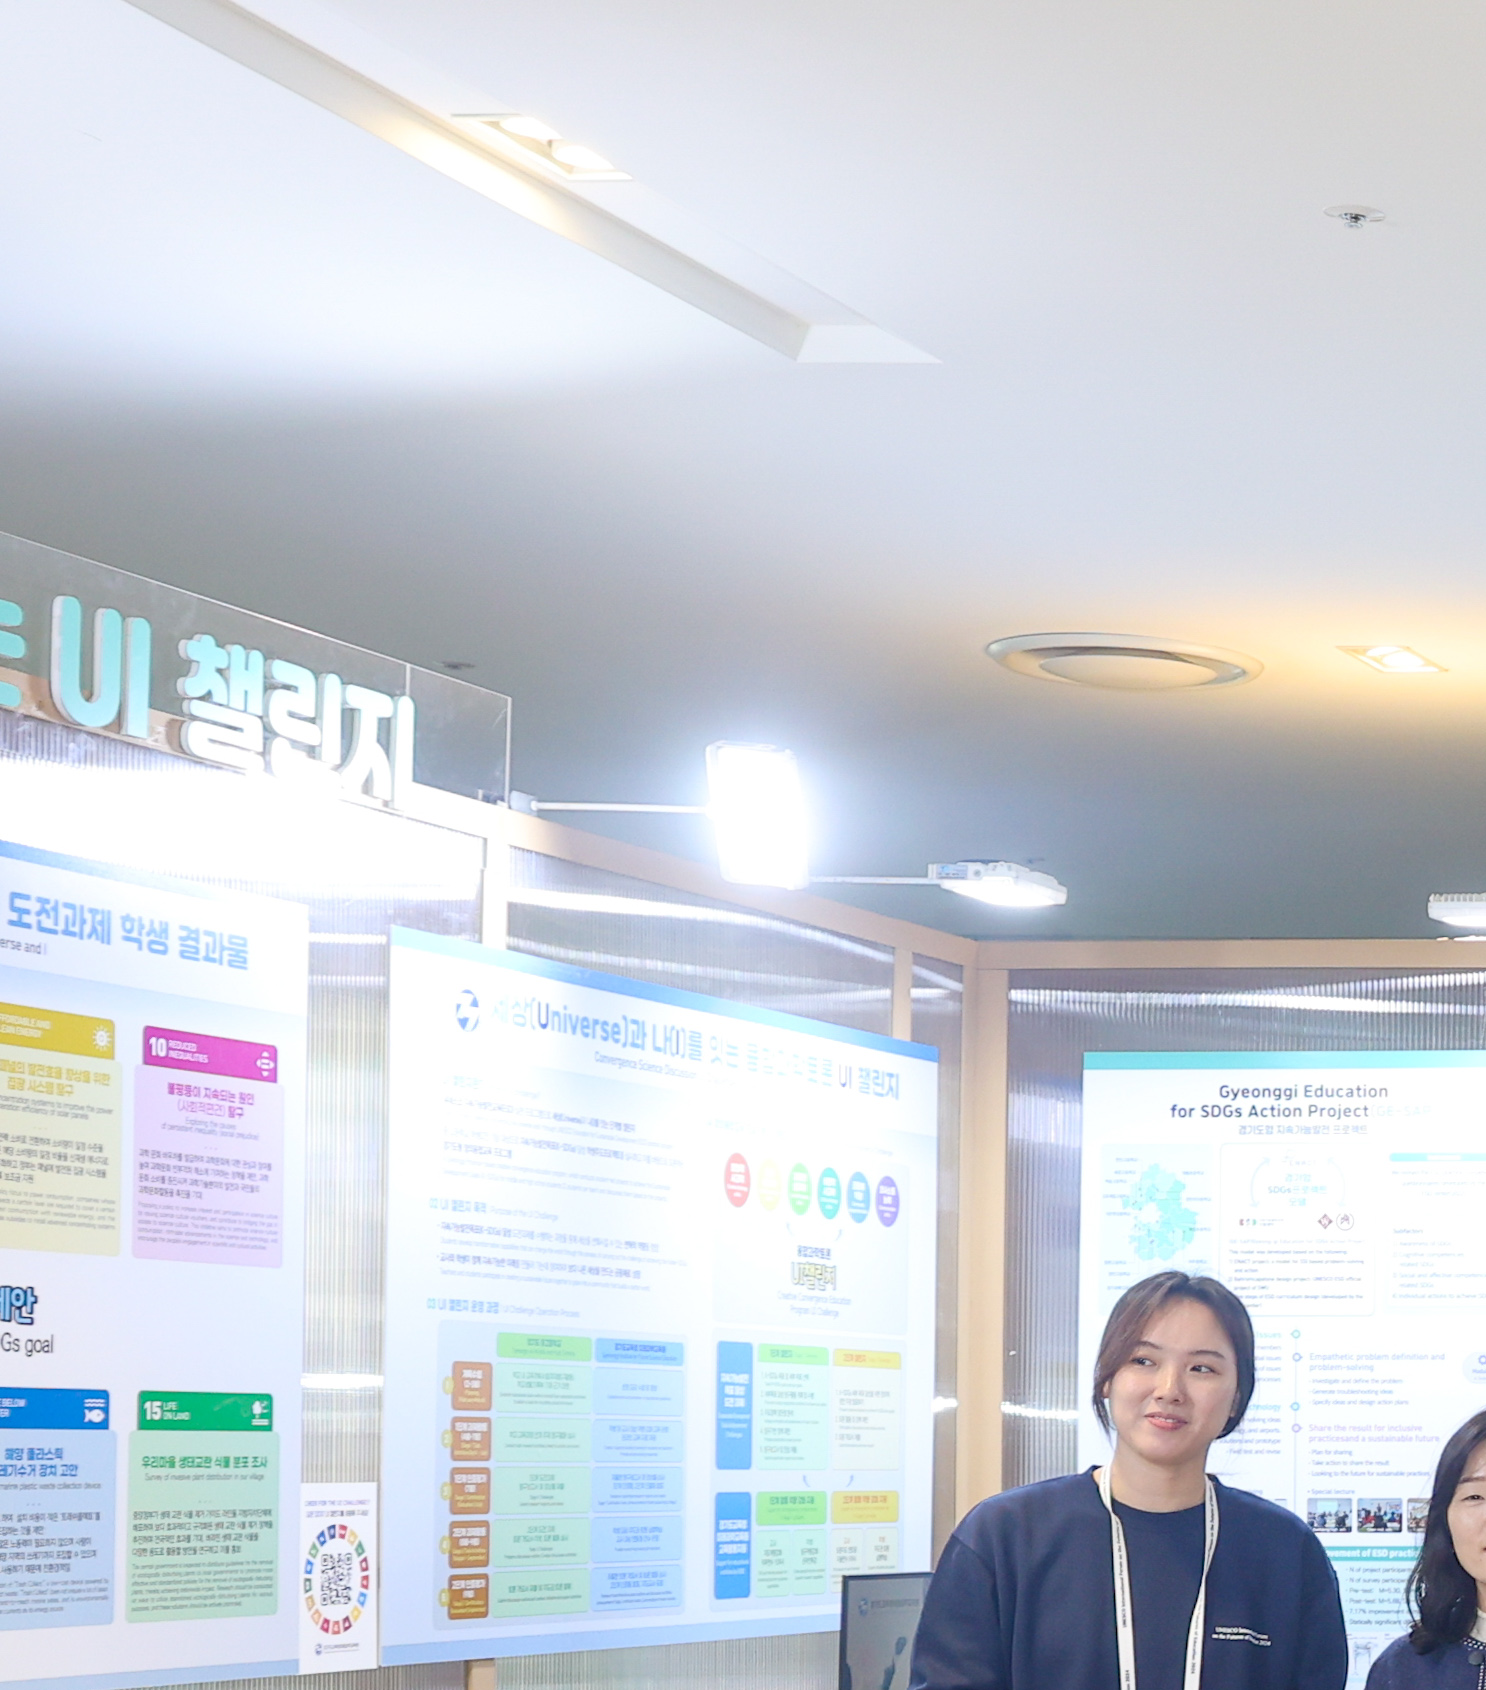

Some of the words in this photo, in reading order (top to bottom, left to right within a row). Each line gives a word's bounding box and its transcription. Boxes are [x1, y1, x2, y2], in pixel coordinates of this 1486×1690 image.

[51, 595, 151, 739] UI
[177, 634, 416, 808] 챌린지
[8, 891, 112, 945] 도전과제
[120, 913, 170, 956] 학생
[179, 924, 249, 971] 결과물
[24, 942, 42, 955] and
[149, 1036, 168, 1057] 10
[168, 1039, 197, 1052] REDUCED
[594, 1050, 636, 1073] Convergence
[858, 1066, 900, 1102] 챌린지
[203, 1085, 236, 1102] 지속되는
[1219, 1085, 1298, 1100] Gyeonggi
[1303, 1085, 1388, 1098] Education
[1171, 1104, 1195, 1117] for
[1200, 1104, 1242, 1118] SDGs
[1248, 1104, 1302, 1117] Action
[24, 1333, 54, 1357] goal
[1357, 1353, 1389, 1363] problem
[1431, 1353, 1445, 1361] and
[143, 1400, 162, 1421] 15
[163, 1401, 179, 1411] LIFE
[173, 1411, 191, 1421] LAND
[142, 1455, 176, 1469] 우리마을
[251, 1456, 268, 1469] 조사
